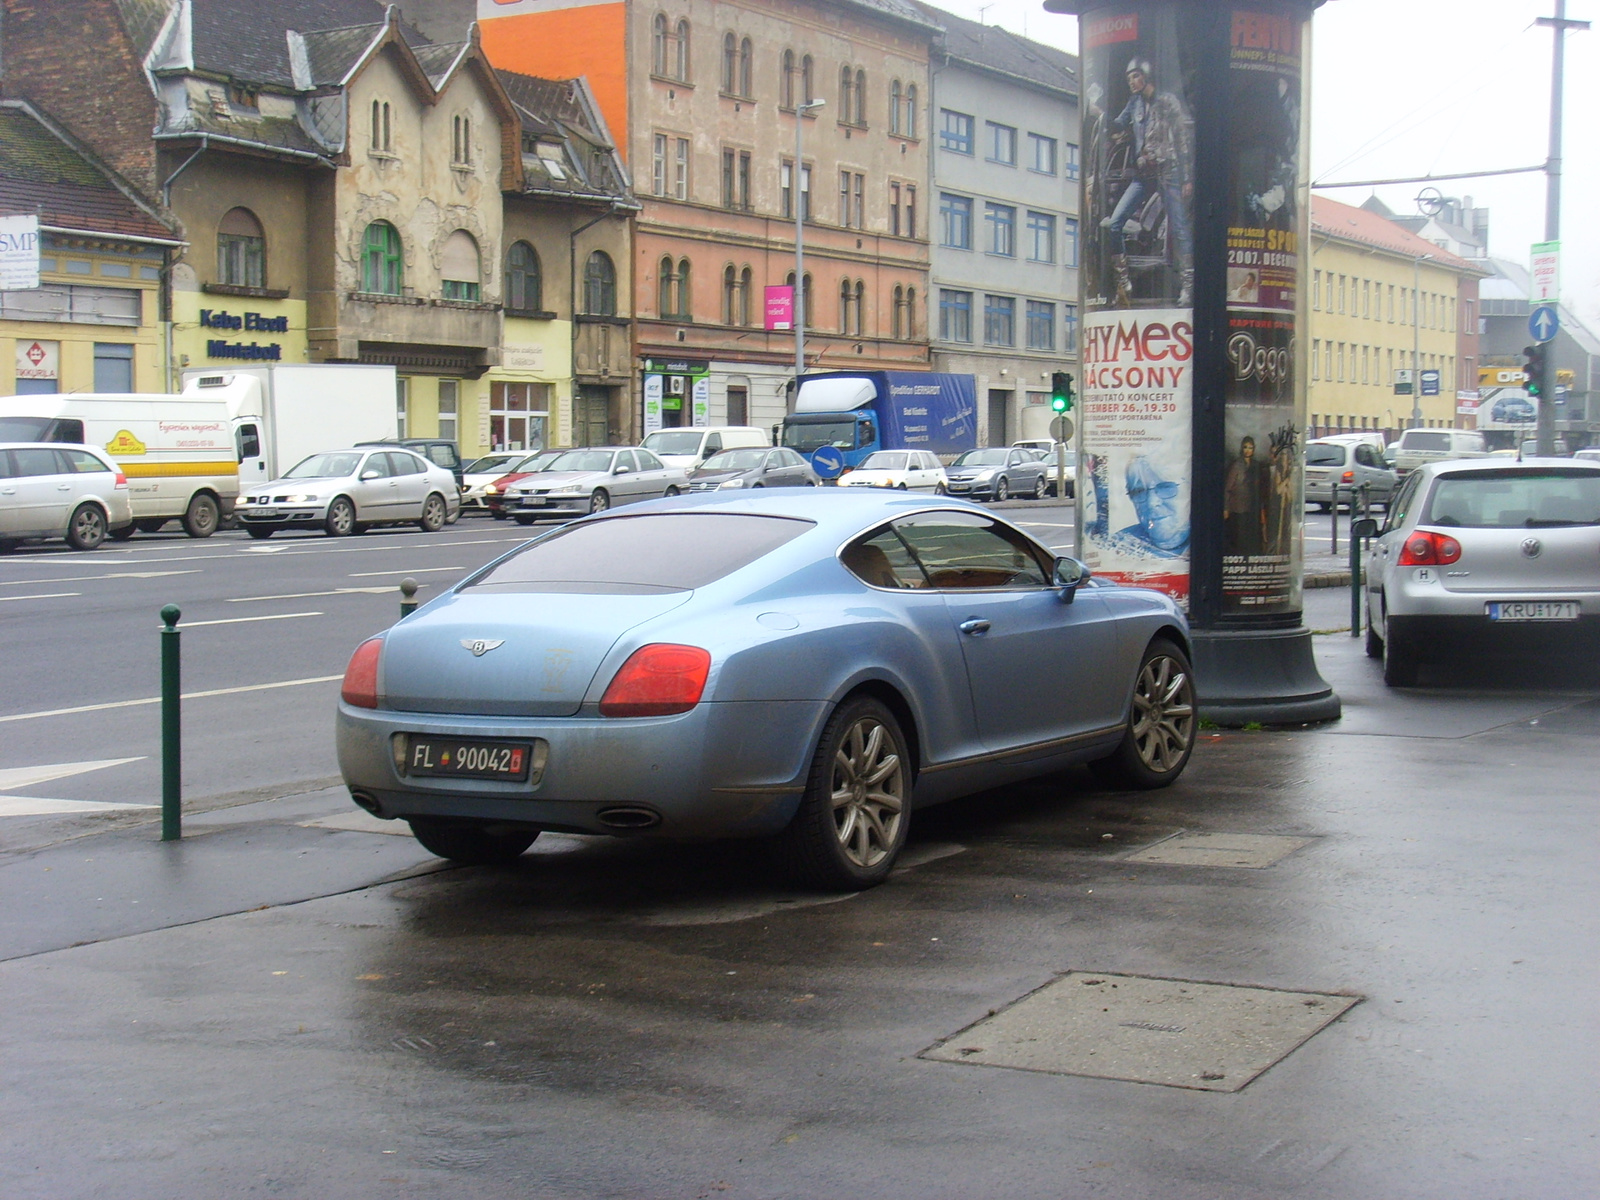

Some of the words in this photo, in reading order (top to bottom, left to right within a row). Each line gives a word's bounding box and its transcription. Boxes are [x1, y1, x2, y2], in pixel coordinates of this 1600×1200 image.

[1227, 238, 1265, 249] BUDAPEST
[1228, 250, 1261, 265] 2007.
[1127, 393, 1174, 402] KONCERT
[1223, 566, 1246, 574] PAPP
[413, 745, 434, 768] FL
[457, 747, 511, 772] 90042
